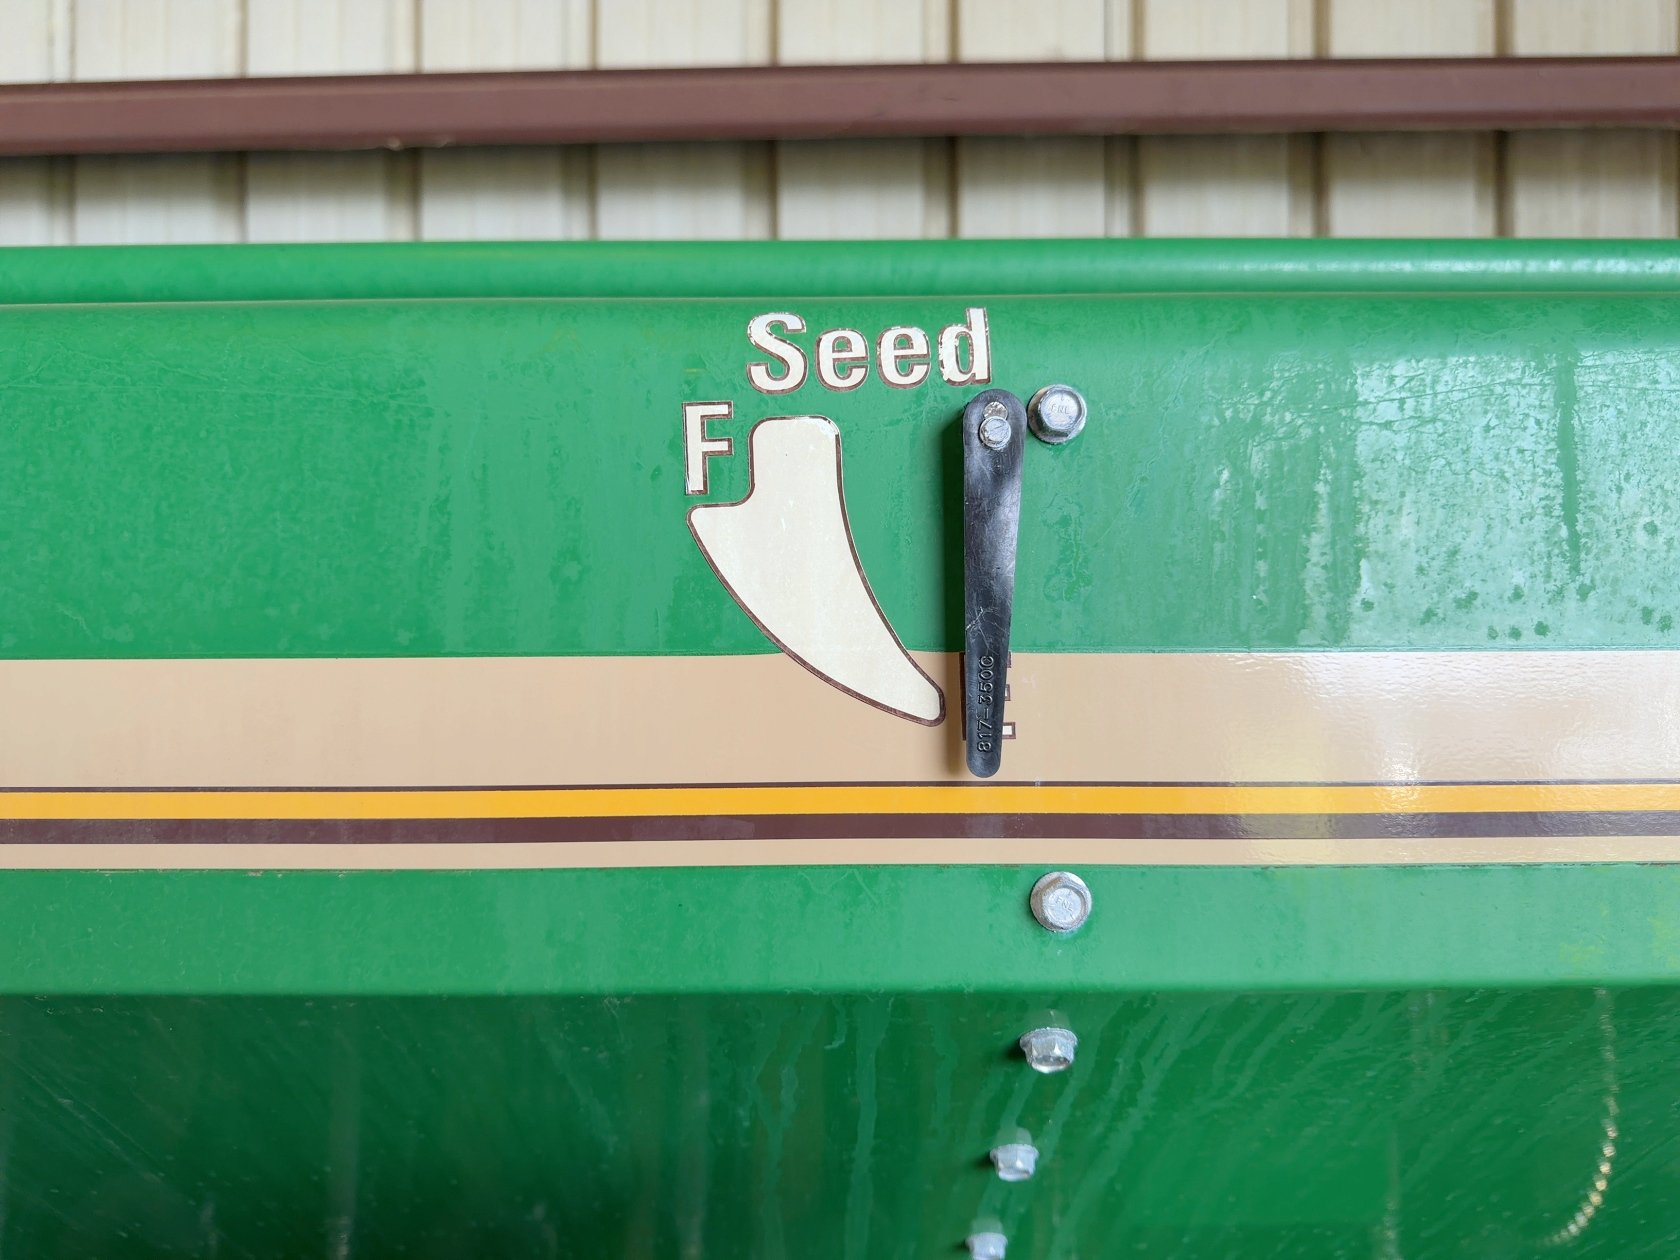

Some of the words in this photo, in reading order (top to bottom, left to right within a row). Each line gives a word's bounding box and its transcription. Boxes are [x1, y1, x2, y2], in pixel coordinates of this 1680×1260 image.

[746, 307, 993, 395] Seed
[682, 401, 734, 496] F
[976, 655, 995, 753] 817-350C
